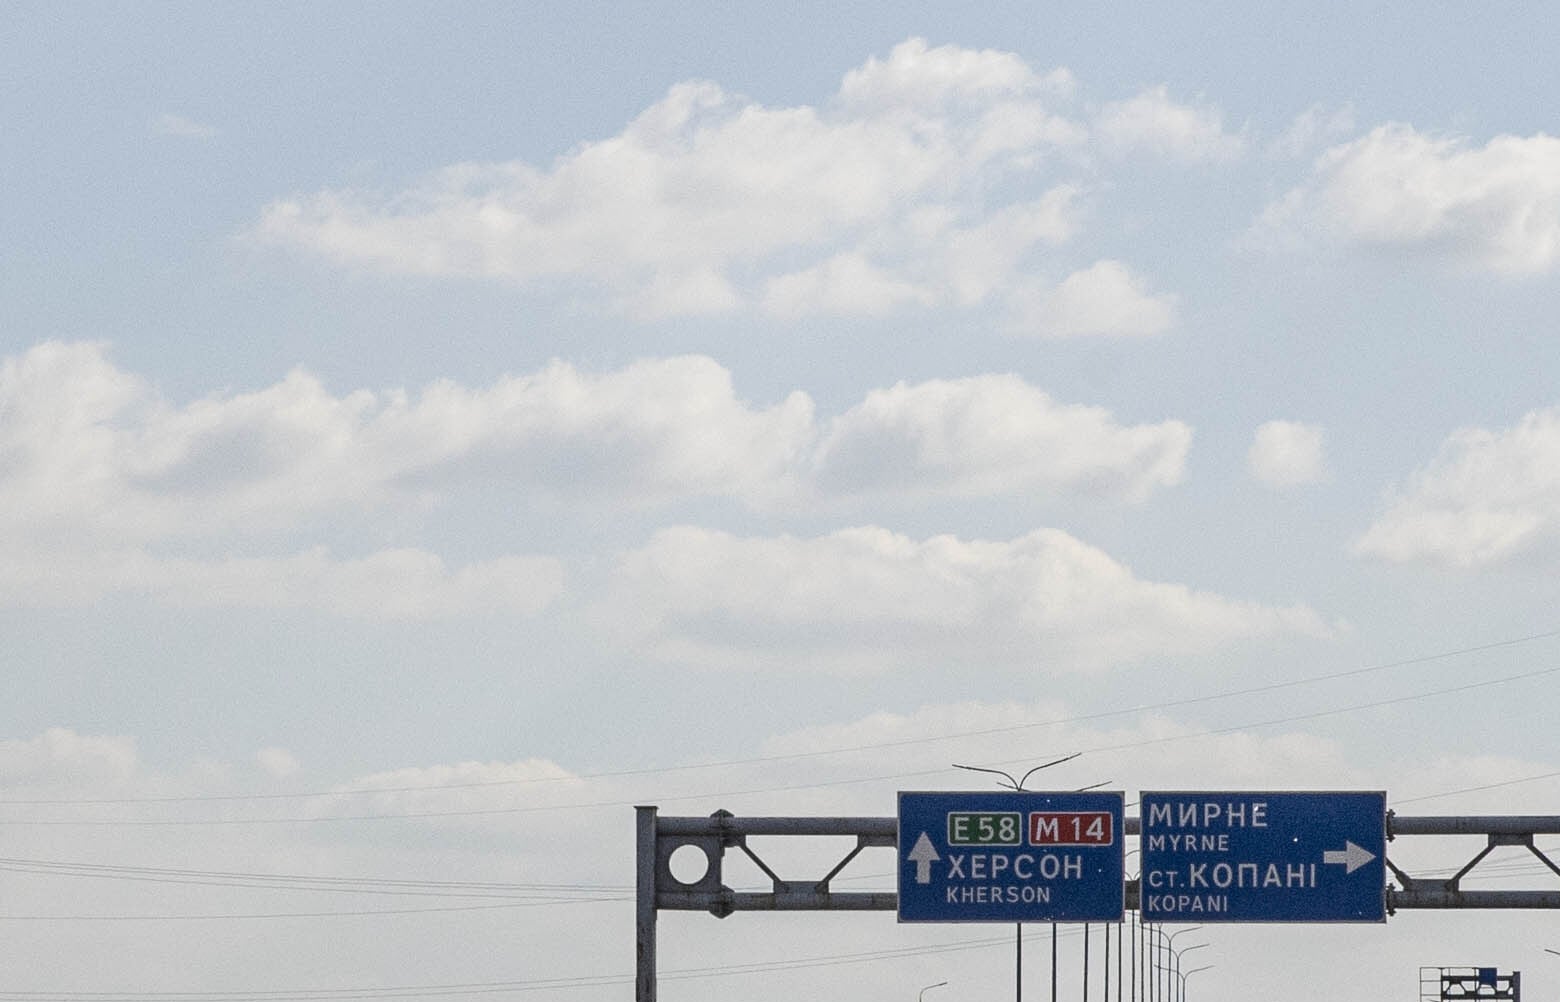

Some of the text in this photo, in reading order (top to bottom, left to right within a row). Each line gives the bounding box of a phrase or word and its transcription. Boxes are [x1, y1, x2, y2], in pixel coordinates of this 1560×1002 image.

[1148, 802, 1269, 828] МИРНЕ
[1148, 834, 1230, 852] MYRNE
[947, 854, 1083, 880] ХЕРСОН
[946, 886, 1051, 904] KHERSON
[1148, 895, 1229, 913] KOPANI
